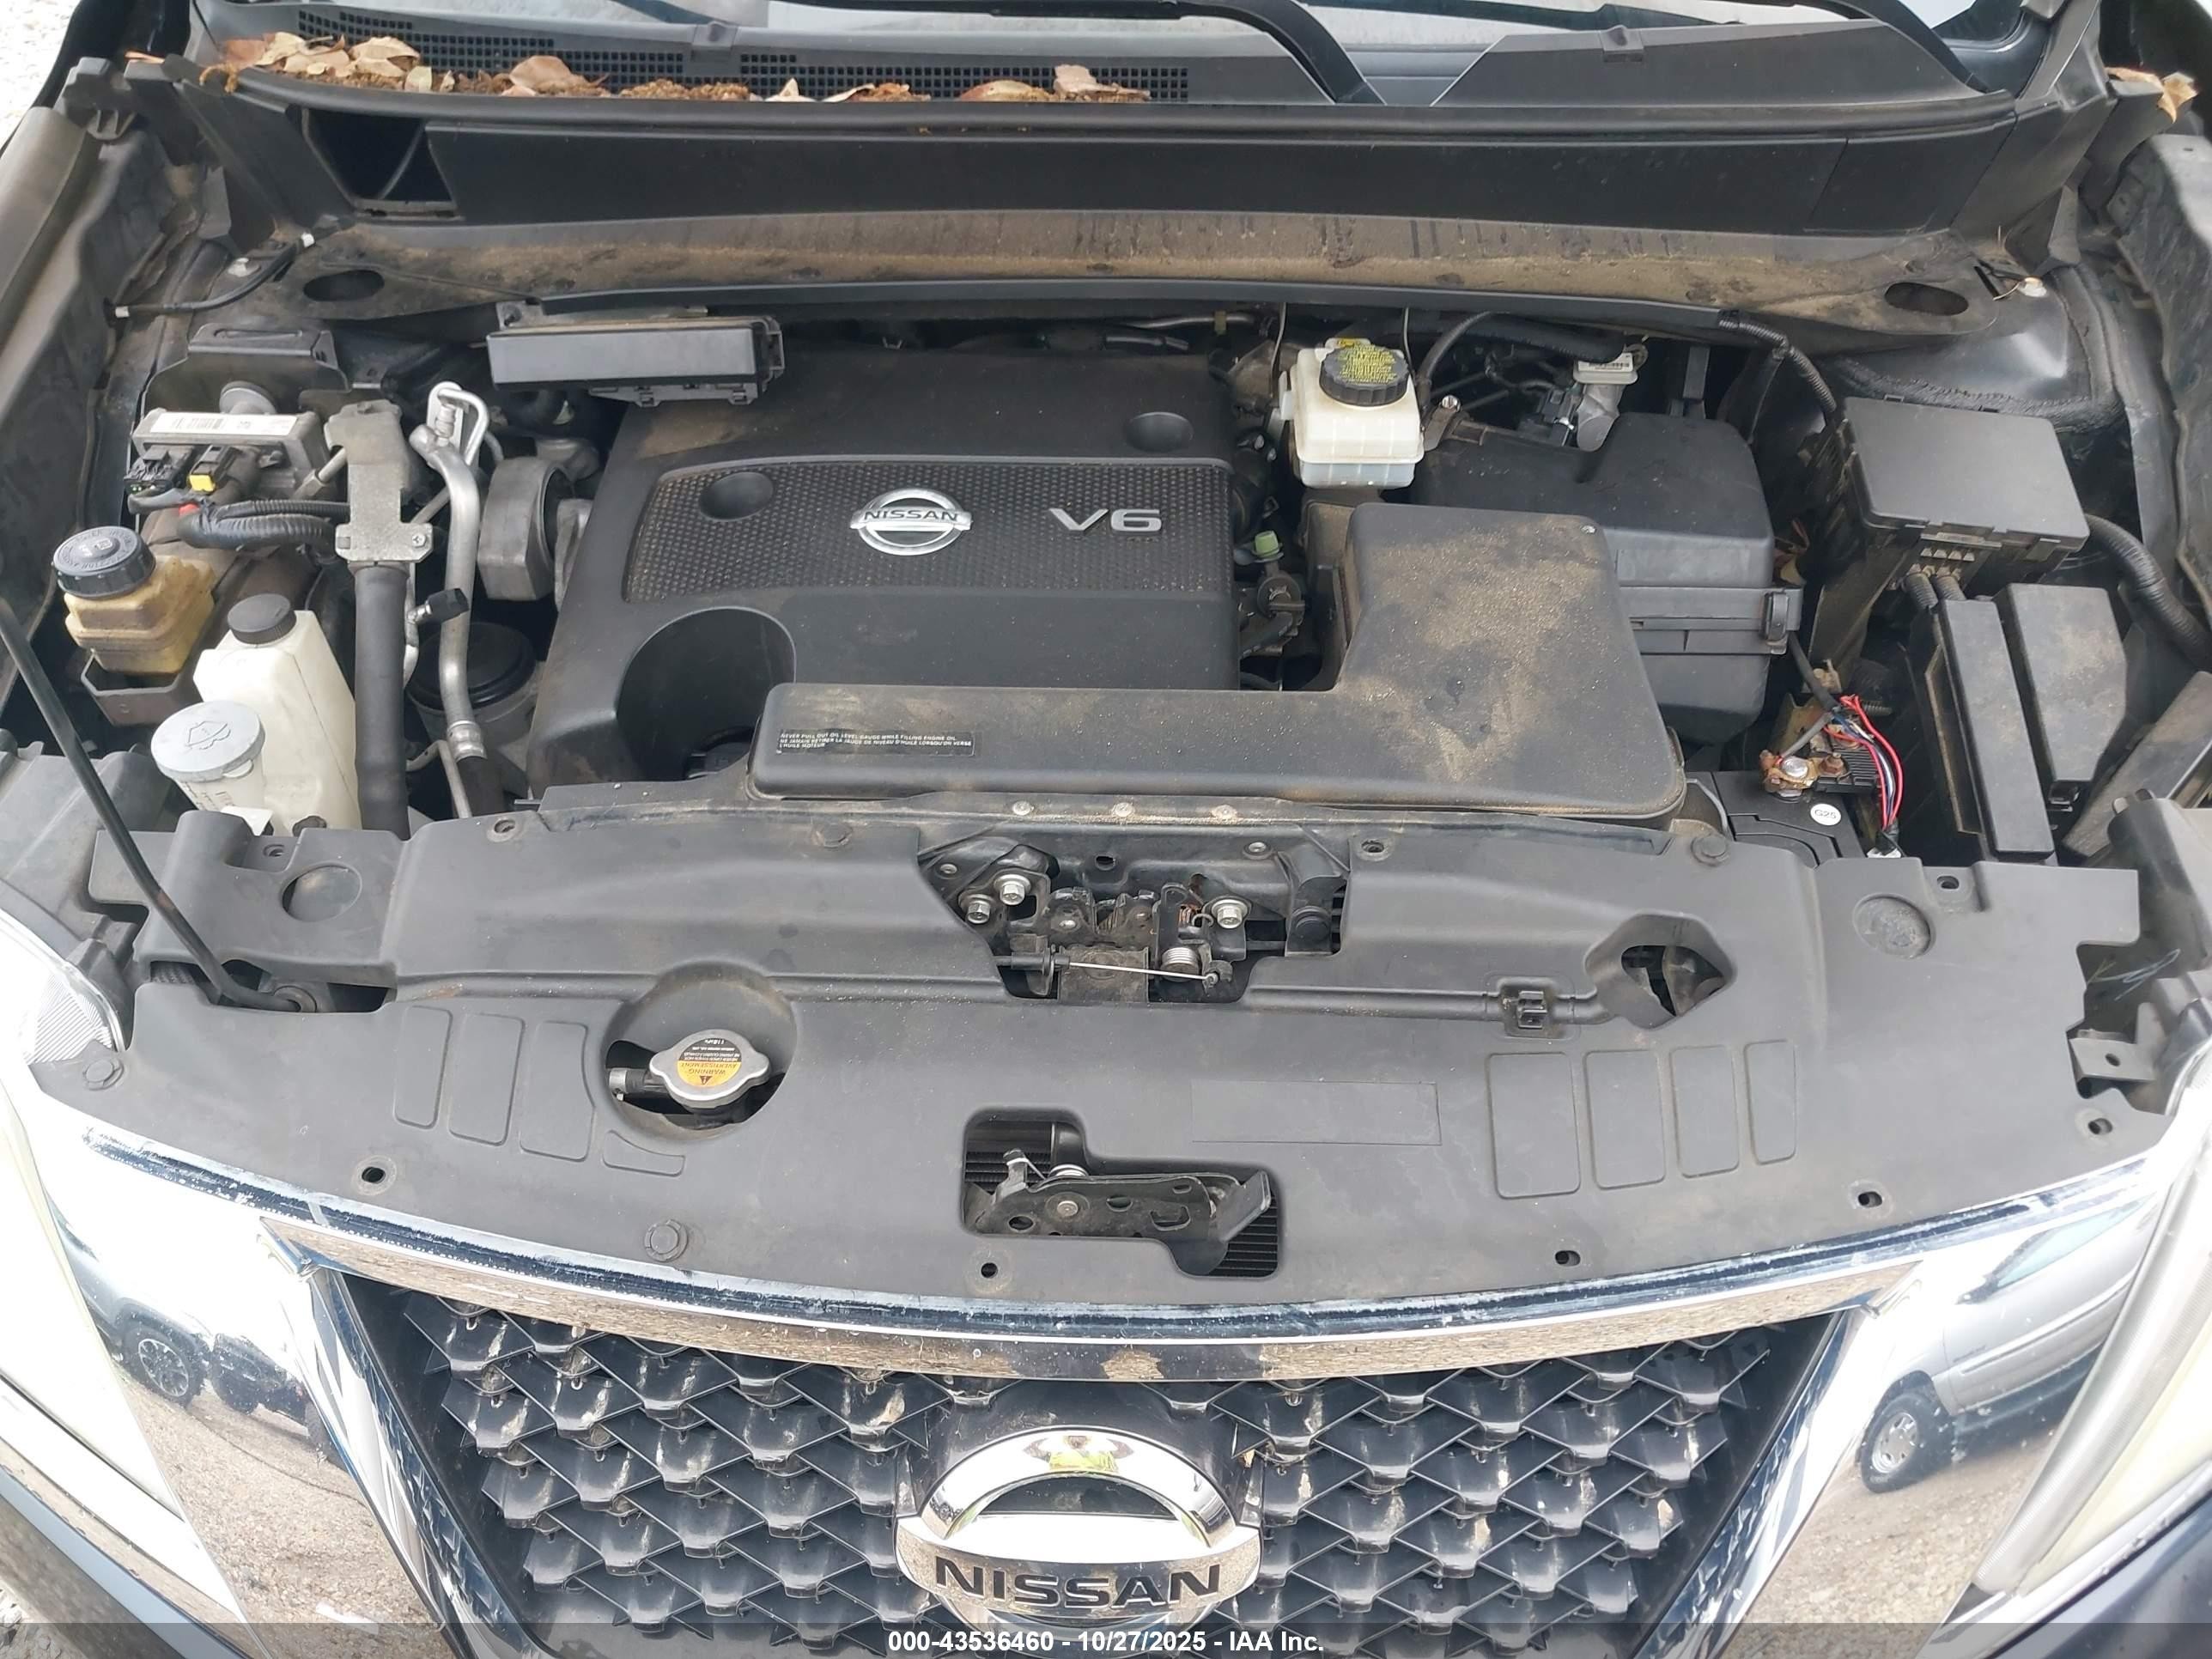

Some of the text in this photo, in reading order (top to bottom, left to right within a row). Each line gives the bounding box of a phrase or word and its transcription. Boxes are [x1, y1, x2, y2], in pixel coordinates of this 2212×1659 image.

[863, 510, 959, 521] NISSAN
[1048, 507, 1162, 532] V6
[935, 1556, 1221, 1609] NISSAN
